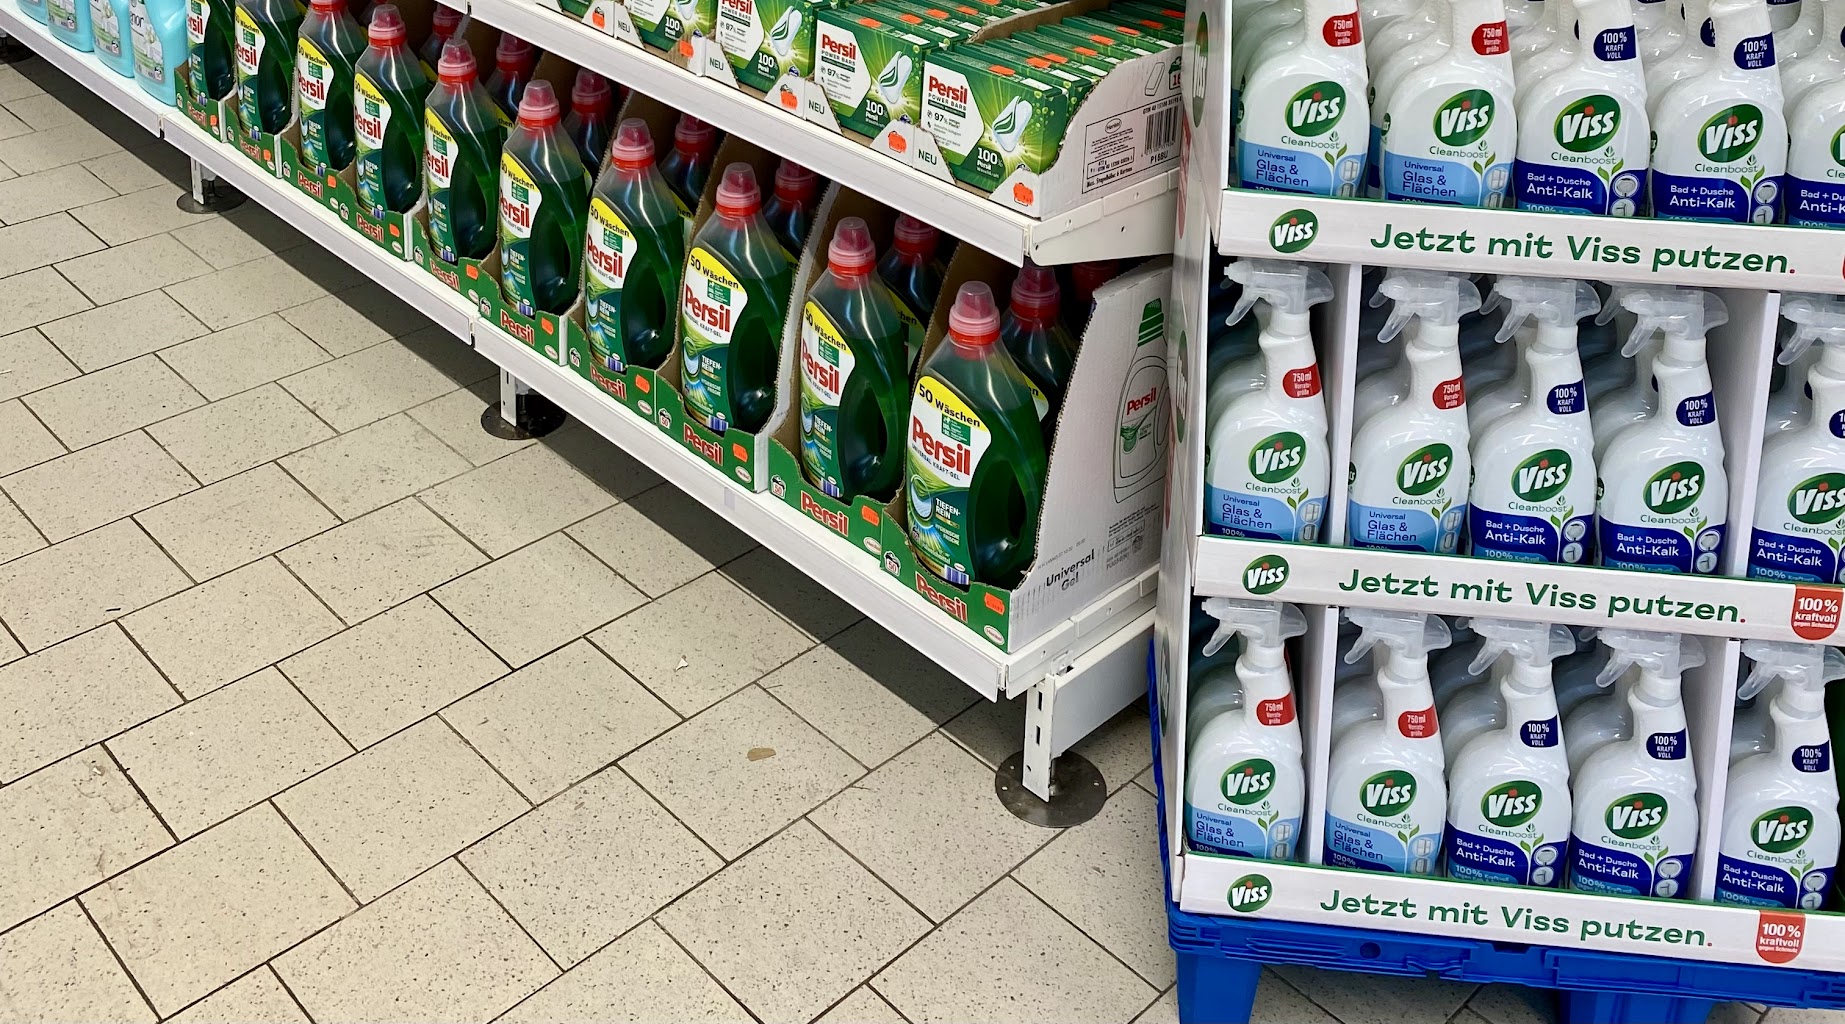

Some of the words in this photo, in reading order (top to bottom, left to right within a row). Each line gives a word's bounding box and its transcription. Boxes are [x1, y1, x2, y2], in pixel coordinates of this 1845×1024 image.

[821, 34, 856, 60] Persil
[1606, 44, 1623, 52] KRAFT
[1607, 51, 1621, 59] VOLL
[710, 57, 724, 71] NEU
[929, 75, 967, 104] Persil
[808, 99, 825, 114] NEU
[1291, 92, 1340, 127] Viss
[1440, 100, 1490, 137] Viss
[1563, 105, 1614, 143] Viss
[1706, 115, 1758, 154] Viss
[1281, 136, 1340, 149] Cleanboost
[919, 149, 937, 165] NEU
[1256, 160, 1286, 174] Glas
[1289, 164, 1299, 174] &
[1258, 150, 1296, 162] Universal
[1551, 152, 1616, 165] Cleanboost
[1256, 168, 1309, 187] Flächen
[1402, 180, 1456, 197] Flächen
[1403, 171, 1435, 186] Glas
[1437, 176, 1447, 185] &
[1527, 173, 1545, 182] Bad
[1557, 176, 1591, 186] Dusche
[1526, 183, 1593, 199] Anti-Kalk
[1670, 185, 1688, 194] Bad
[1700, 188, 1734, 196] Dusche
[1670, 195, 1735, 209] Anti-Kalk
[1274, 217, 1314, 247] Viss
[1370, 223, 1476, 254] Jetzt
[1488, 234, 1554, 259] mit
[1566, 235, 1641, 264] Viss
[1653, 242, 1796, 274] putzen.
[690, 255, 701, 271] 50
[702, 266, 739, 289] Wäschen
[685, 284, 731, 333] Persil
[501, 310, 534, 345] Persil
[801, 337, 840, 396] Persil
[590, 364, 626, 401] Persil
[919, 384, 933, 403] 50
[936, 400, 980, 427] Wäschen
[1126, 387, 1156, 415] Persil
[684, 424, 724, 466] Persil
[913, 415, 970, 475] Persil
[933, 460, 960, 480] KRAFT-GEL
[1255, 442, 1300, 474] Viss
[1403, 454, 1448, 488] Viss
[1519, 459, 1568, 494] Viss
[1651, 472, 1700, 507] Viss
[802, 490, 848, 536] Persil
[936, 498, 960, 516] TIEFEN-
[936, 506, 951, 519] REIN
[1222, 503, 1252, 517] Glas
[1254, 509, 1263, 517] &
[1222, 513, 1272, 529] Flächen
[1367, 530, 1416, 542] Flächen
[1485, 530, 1546, 545] Anti-Kalk
[1617, 543, 1679, 557] Anti-Kalk
[1757, 549, 1822, 567] Anti-Kalk
[887, 559, 898, 572] 50
[1046, 548, 1094, 587] Universal
[1247, 562, 1286, 586] Viss
[916, 572, 968, 623] Persil
[1338, 568, 1440, 598] Jetzt
[1451, 579, 1514, 604] mit
[1526, 583, 1597, 610] Viss
[1608, 594, 1746, 623] putzen.
[1795, 610, 1838, 622] kraftvoll
[1227, 767, 1270, 797] Viss
[1366, 779, 1411, 807] Viss
[1488, 788, 1536, 817] Viss
[1612, 801, 1663, 830] Viss
[1196, 831, 1244, 848] Flächen
[1758, 815, 1808, 844] Viss
[1334, 839, 1383, 861] Flächen
[1456, 848, 1516, 868] Anti-Kalk
[1231, 881, 1269, 906] Viss
[1722, 872, 1784, 894] Anti-Kalk
[1320, 889, 1418, 920] Jetzt
[1427, 902, 1491, 927] mit
[1501, 905, 1569, 934] Viss
[1580, 919, 1713, 947] putzen.
[1760, 937, 1800, 949] kraftvoll
